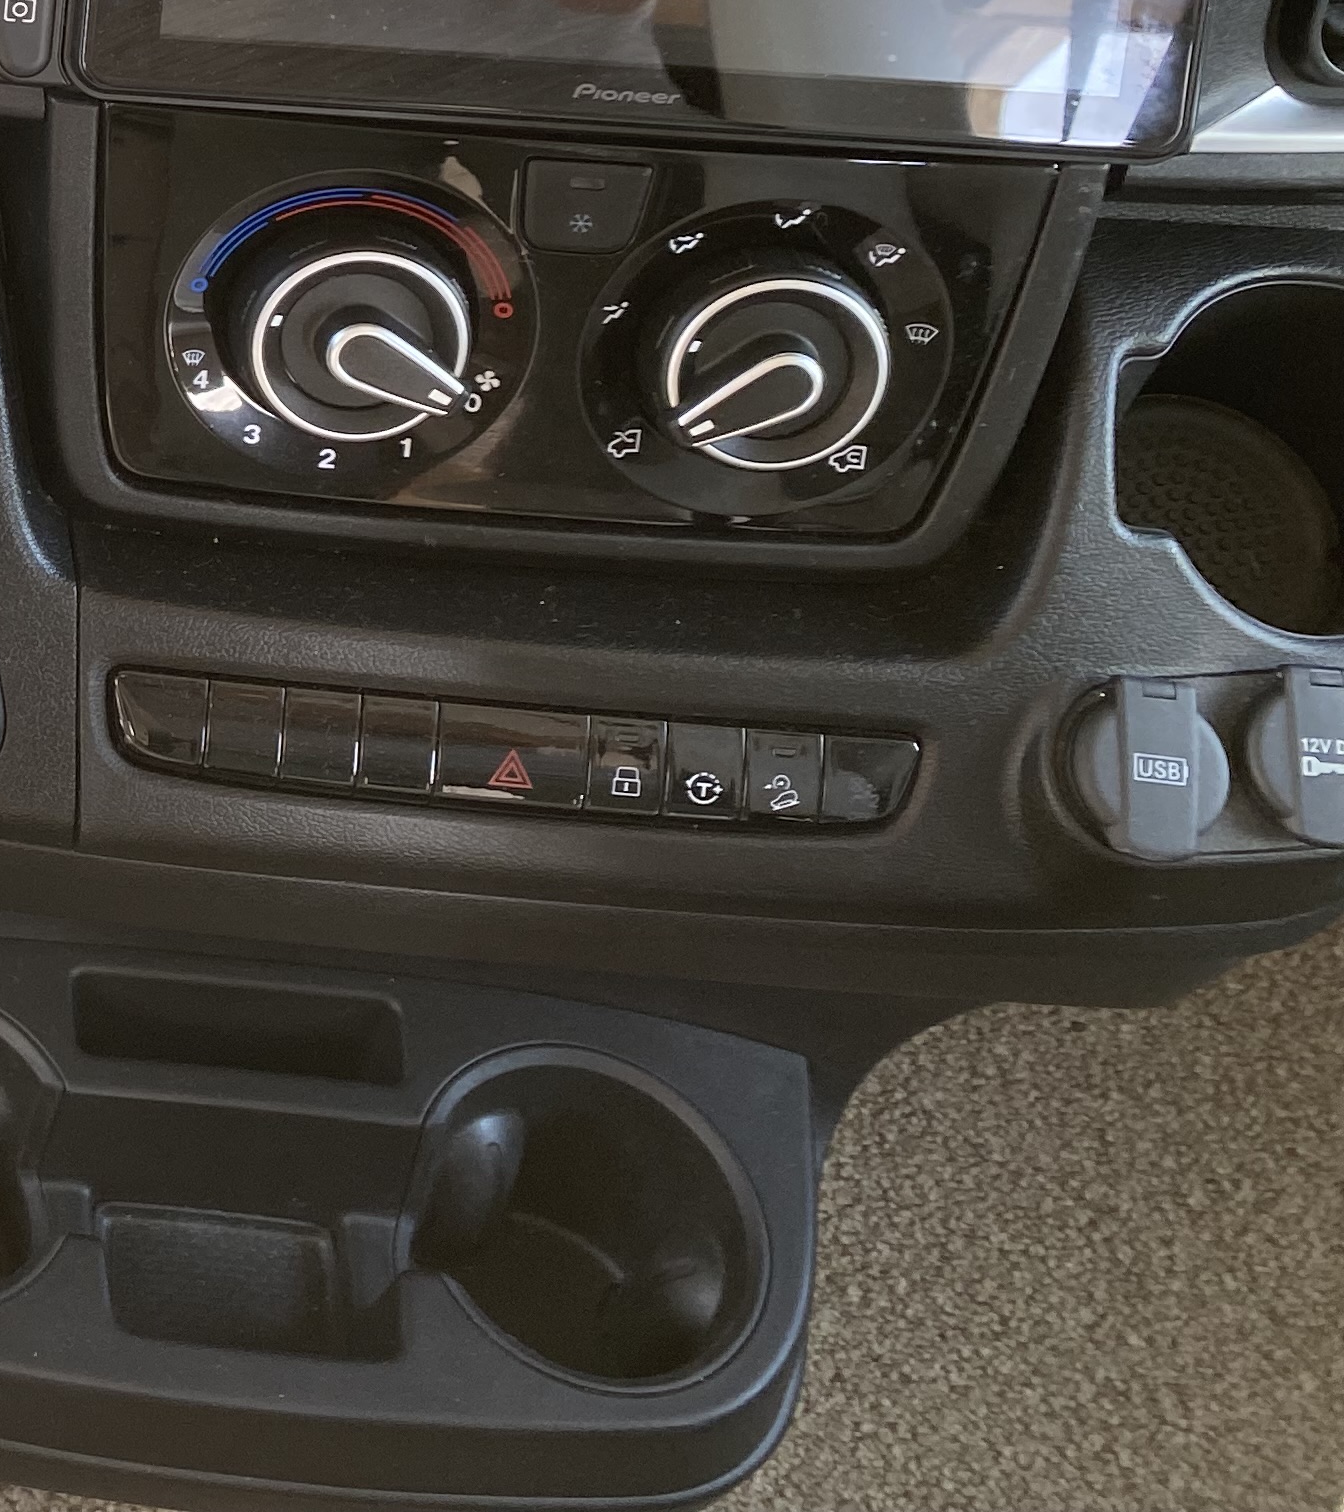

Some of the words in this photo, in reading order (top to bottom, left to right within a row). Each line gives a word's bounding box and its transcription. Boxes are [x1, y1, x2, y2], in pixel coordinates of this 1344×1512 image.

[572, 83, 681, 105] Pioneer
[192, 369, 210, 389] 4
[242, 424, 262, 445] 3
[399, 437, 412, 458] 1
[317, 448, 337, 469] 2
[1300, 737, 1332, 754] 12V
[1138, 758, 1181, 781] USB
